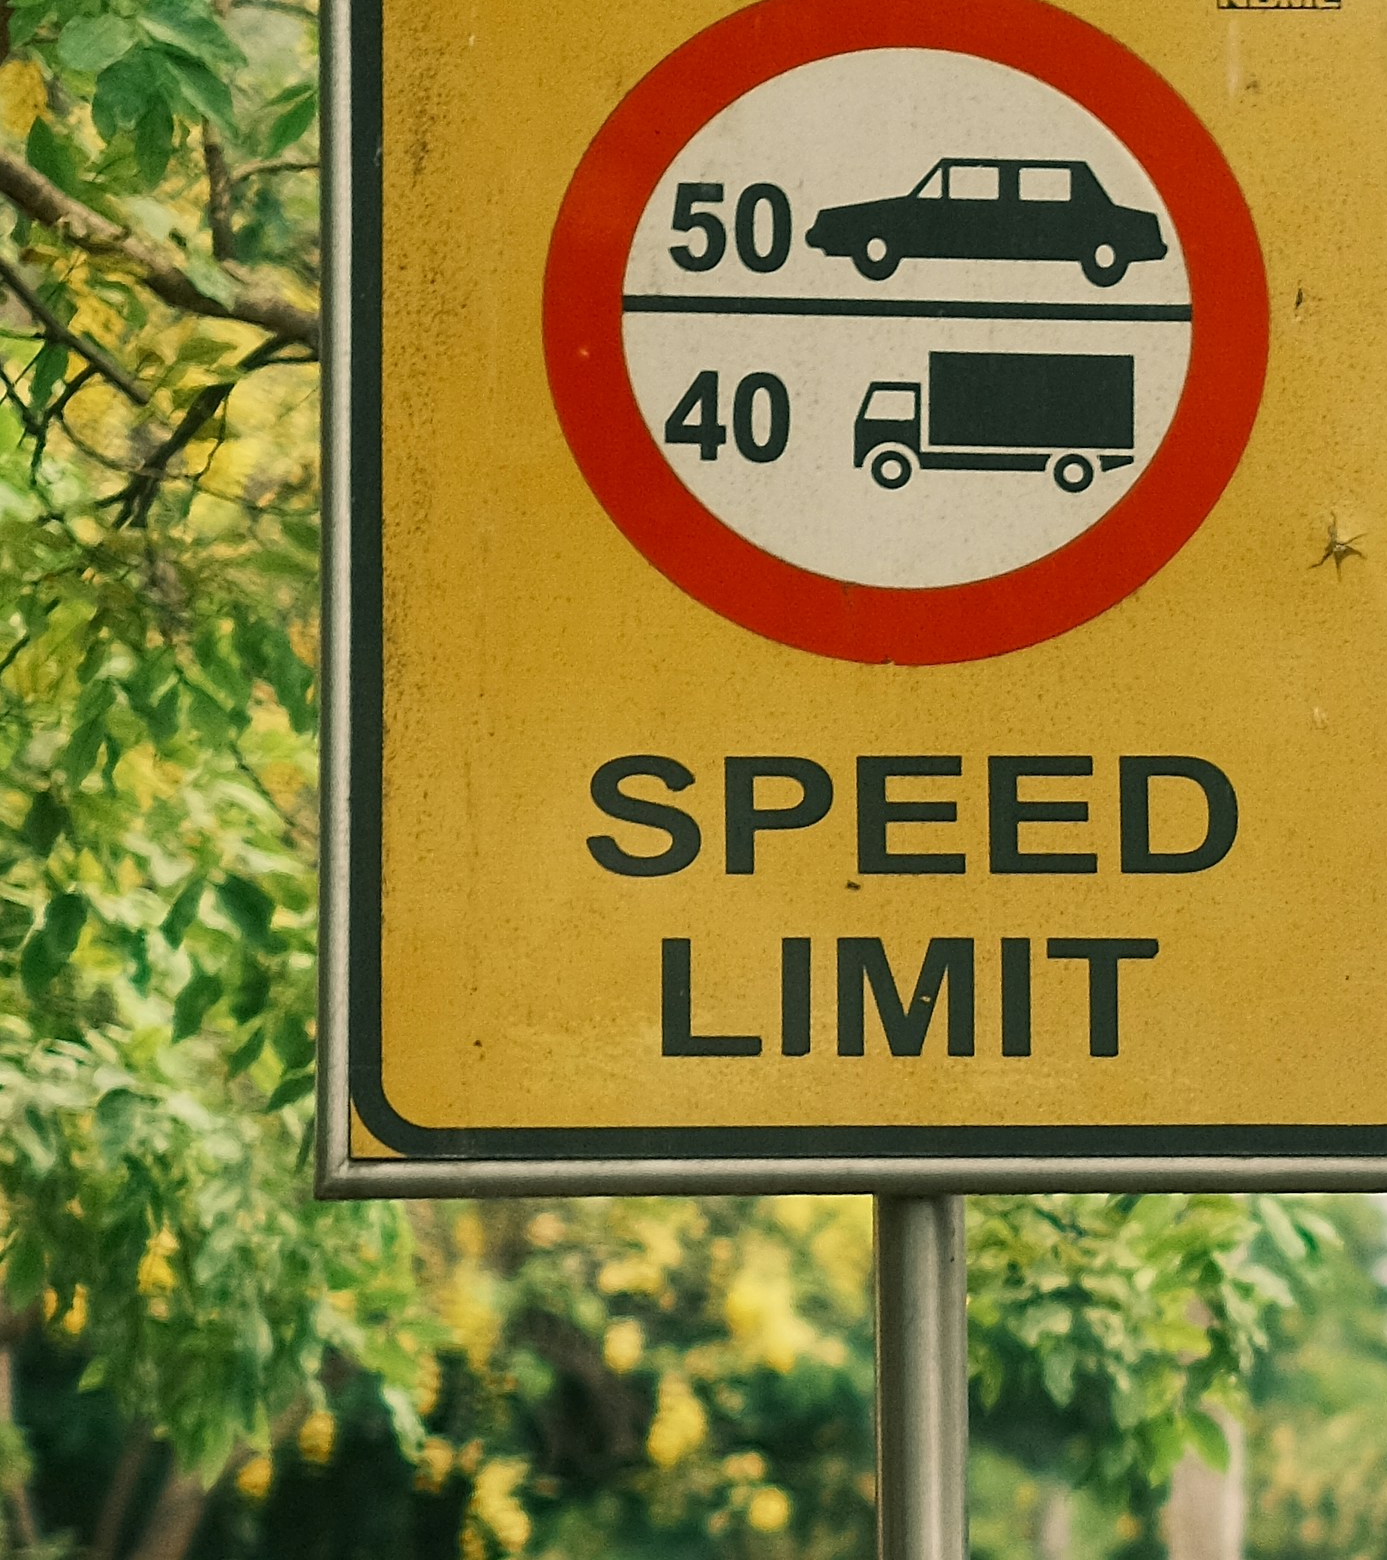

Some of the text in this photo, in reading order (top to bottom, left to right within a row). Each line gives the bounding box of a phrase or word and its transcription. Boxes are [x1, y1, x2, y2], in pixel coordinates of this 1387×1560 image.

[667, 182, 793, 274] 50
[664, 370, 791, 463] 40
[585, 754, 1240, 878] SPEED
[660, 936, 1160, 1058] LIMIT
